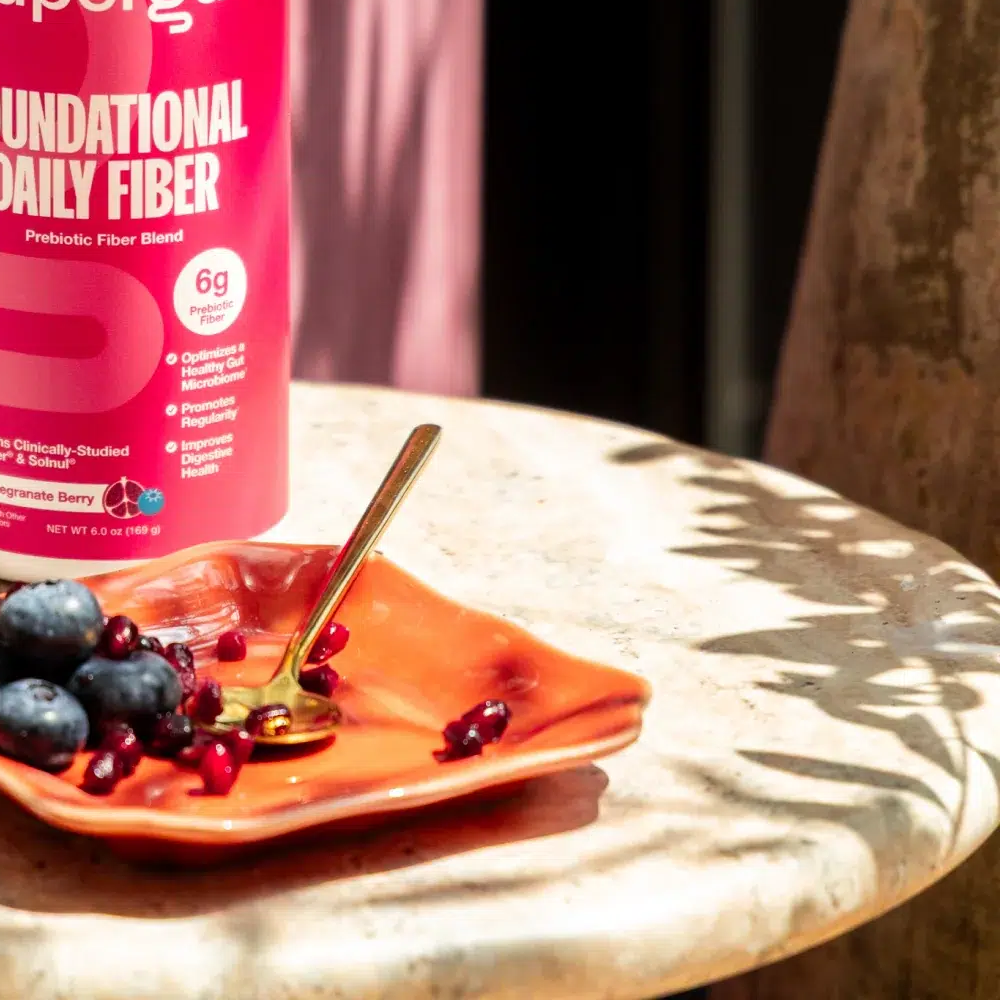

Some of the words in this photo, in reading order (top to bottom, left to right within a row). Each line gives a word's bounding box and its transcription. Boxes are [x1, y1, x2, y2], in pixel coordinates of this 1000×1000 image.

[107, 151, 220, 220] FIBER
[25, 229, 92, 246] Prebiotic
[97, 233, 135, 247] Fiber
[141, 229, 184, 245] Blend
[195, 268, 229, 297] 6g
[189, 300, 234, 316] Prebiotic
[200, 313, 226, 326] Fiber
[181, 345, 237, 365] Optimizes
[181, 361, 224, 378] Healthy
[226, 354, 245, 369] Gut
[181, 396, 236, 415] Promotes
[13, 438, 130, 458] Clinically-Studied
[181, 433, 233, 451] Improves
[16, 454, 26, 465] &
[181, 447, 233, 465] Digestive
[181, 463, 219, 479] Health
[58, 491, 95, 506] Berry
[5, 511, 27, 522] Other
[46, 523, 67, 535] NET
[70, 524, 88, 536] WT
[90, 525, 107, 536] 6.0
[110, 527, 122, 536] oz
[125, 524, 149, 537] (169
[150, 524, 161, 537] g)
